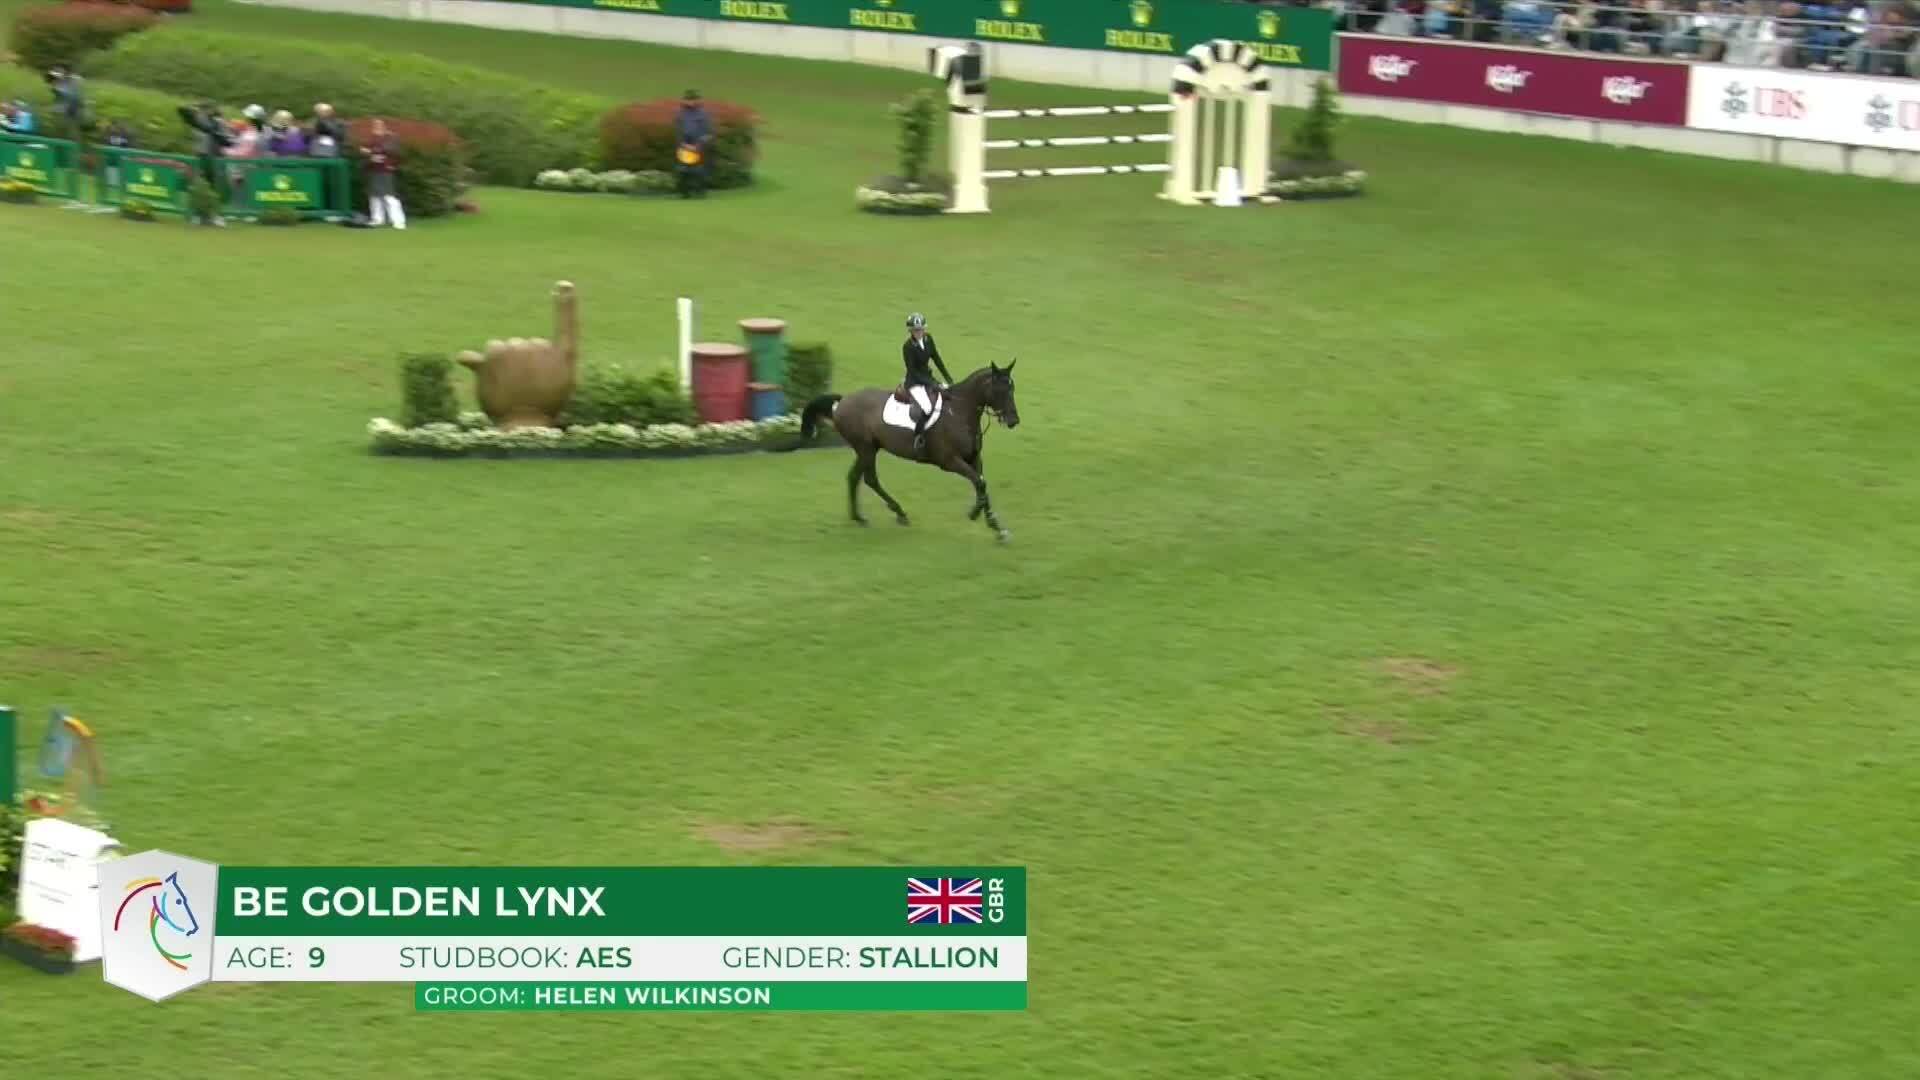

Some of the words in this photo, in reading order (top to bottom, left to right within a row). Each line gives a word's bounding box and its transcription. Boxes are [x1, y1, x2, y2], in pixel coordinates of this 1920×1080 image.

[719, 0, 788, 20] ROLEX
[849, 8, 917, 30] ROLEX
[975, 19, 1043, 41] ROLEX
[1105, 29, 1173, 52] ROLEX
[1248, 41, 1303, 64] OLEX
